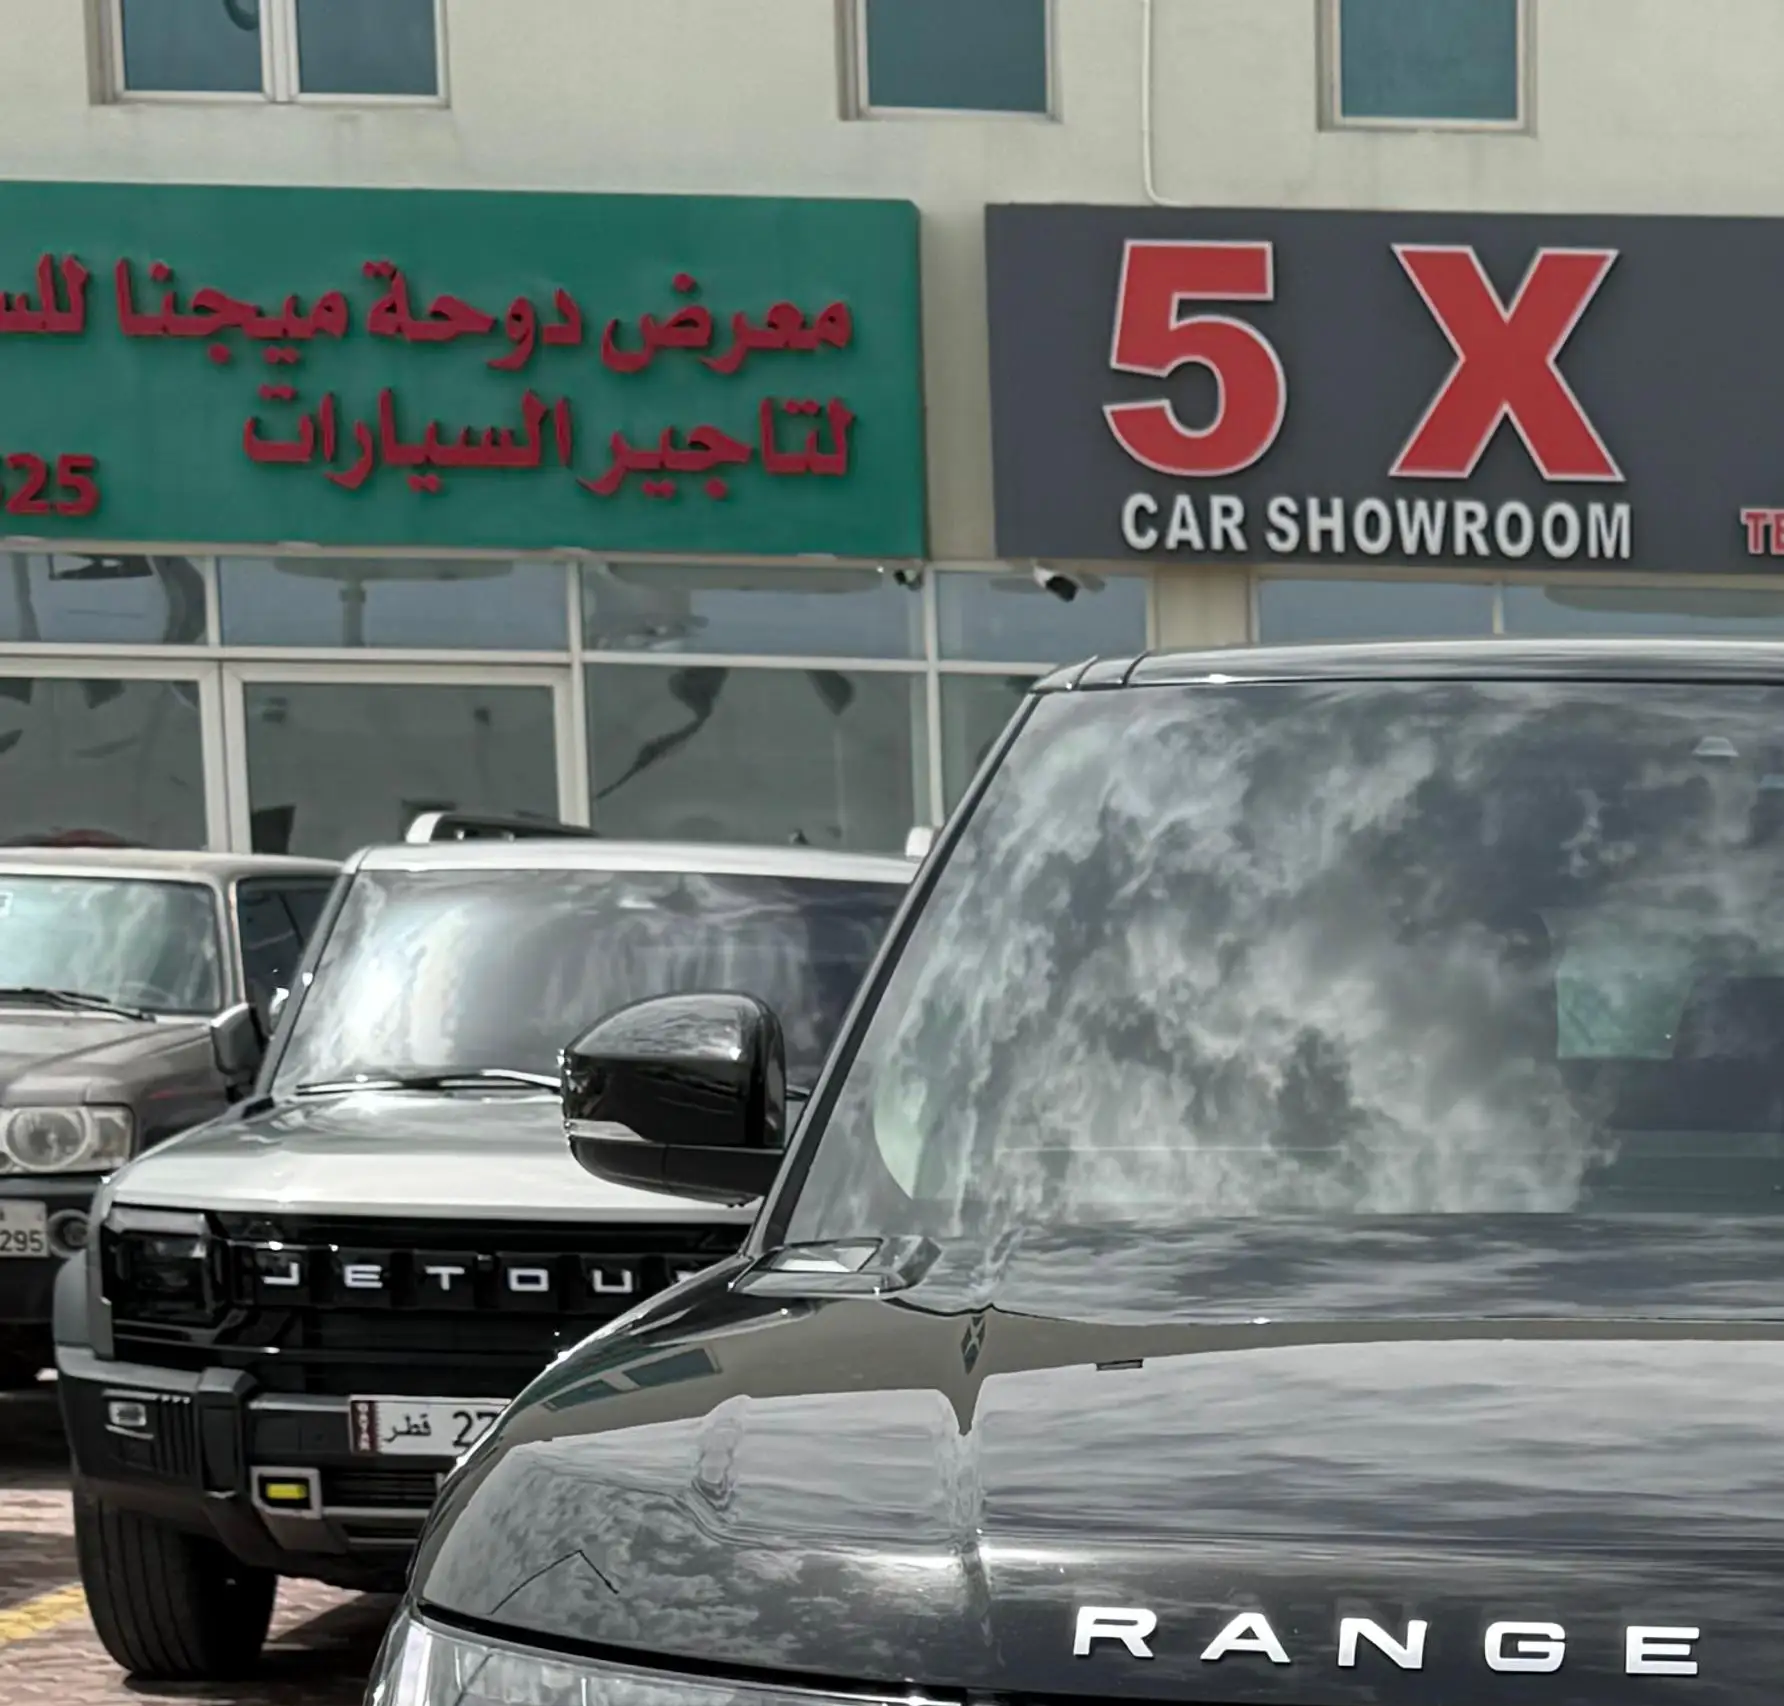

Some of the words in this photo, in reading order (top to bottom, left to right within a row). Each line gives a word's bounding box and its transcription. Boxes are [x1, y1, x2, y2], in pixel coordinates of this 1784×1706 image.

[116, 257, 348, 363] ميجنا
[364, 262, 581, 369] دوحة
[602, 274, 852, 373] معرض
[1103, 240, 1287, 477] 5
[1389, 244, 1625, 482] X
[0, 454, 99, 515] 25
[245, 385, 572, 493] السيارات
[584, 397, 855, 498] لتاجير
[1122, 493, 1246, 551] CAR
[1265, 496, 1632, 559] SHOWROOM
[262, 1262, 698, 1294] JETOU
[383, 1413, 433, 1443] قطر
[1072, 1605, 1700, 1676] RANGE
